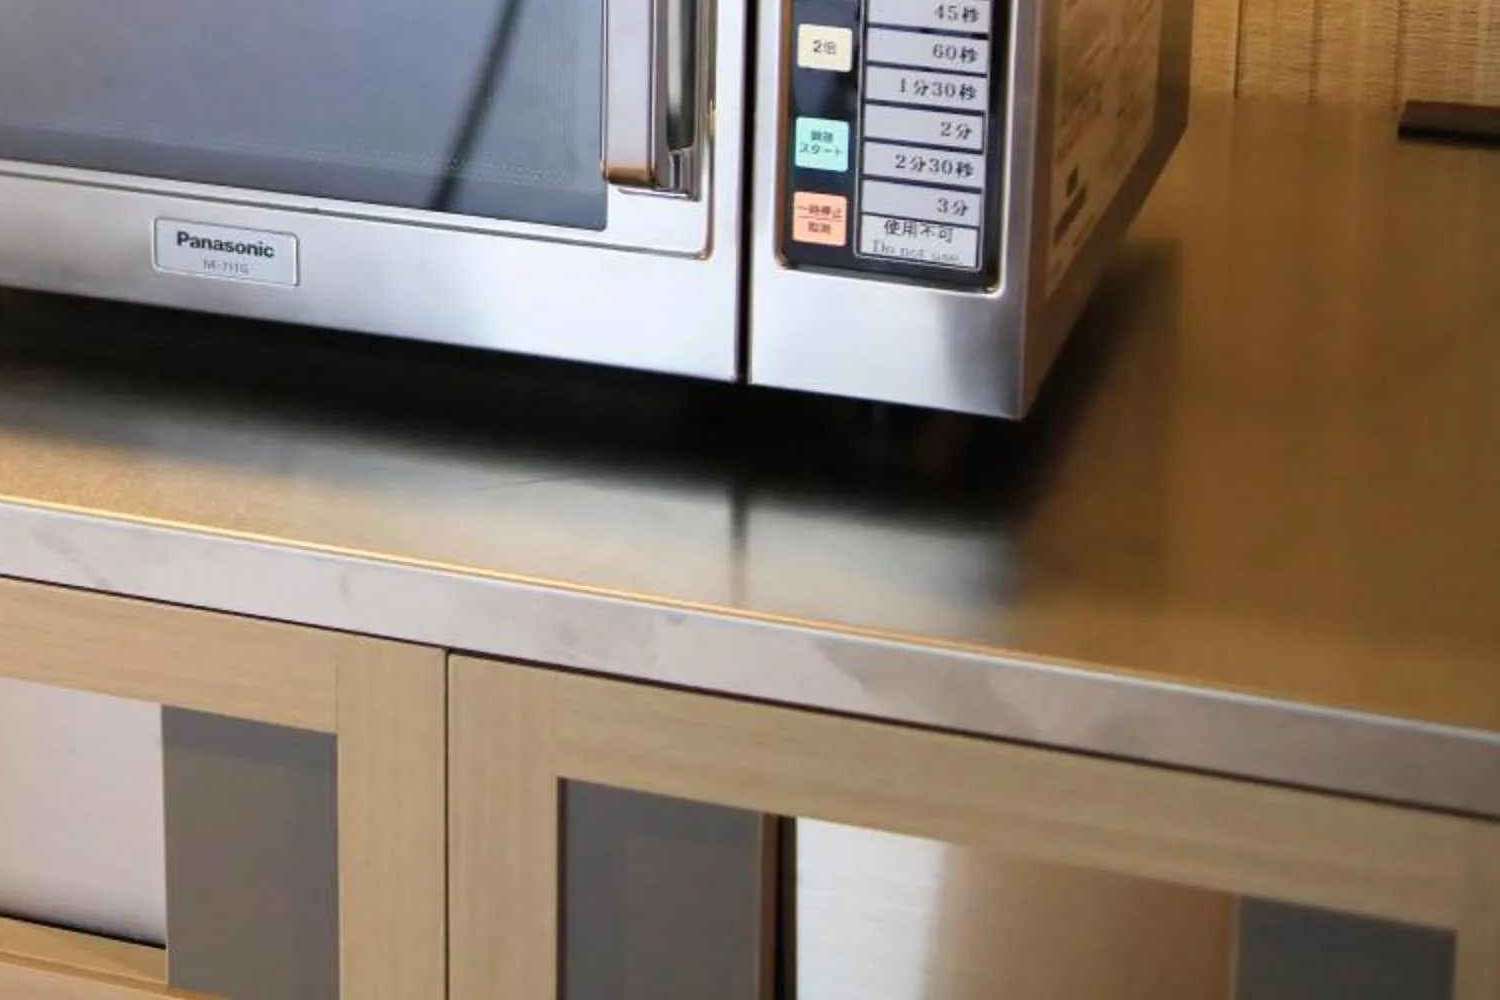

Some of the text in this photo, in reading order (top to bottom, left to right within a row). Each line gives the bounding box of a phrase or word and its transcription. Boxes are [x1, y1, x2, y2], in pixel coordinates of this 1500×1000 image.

[934, 5, 980, 24] 45秒
[932, 43, 979, 64] 60秒
[899, 77, 978, 101] 1分30秒
[940, 121, 973, 141] 2分
[895, 154, 975, 178] 2分30秒
[936, 197, 970, 218] 3分
[884, 221, 955, 244] 使用不可
[176, 231, 275, 258] Panasonic
